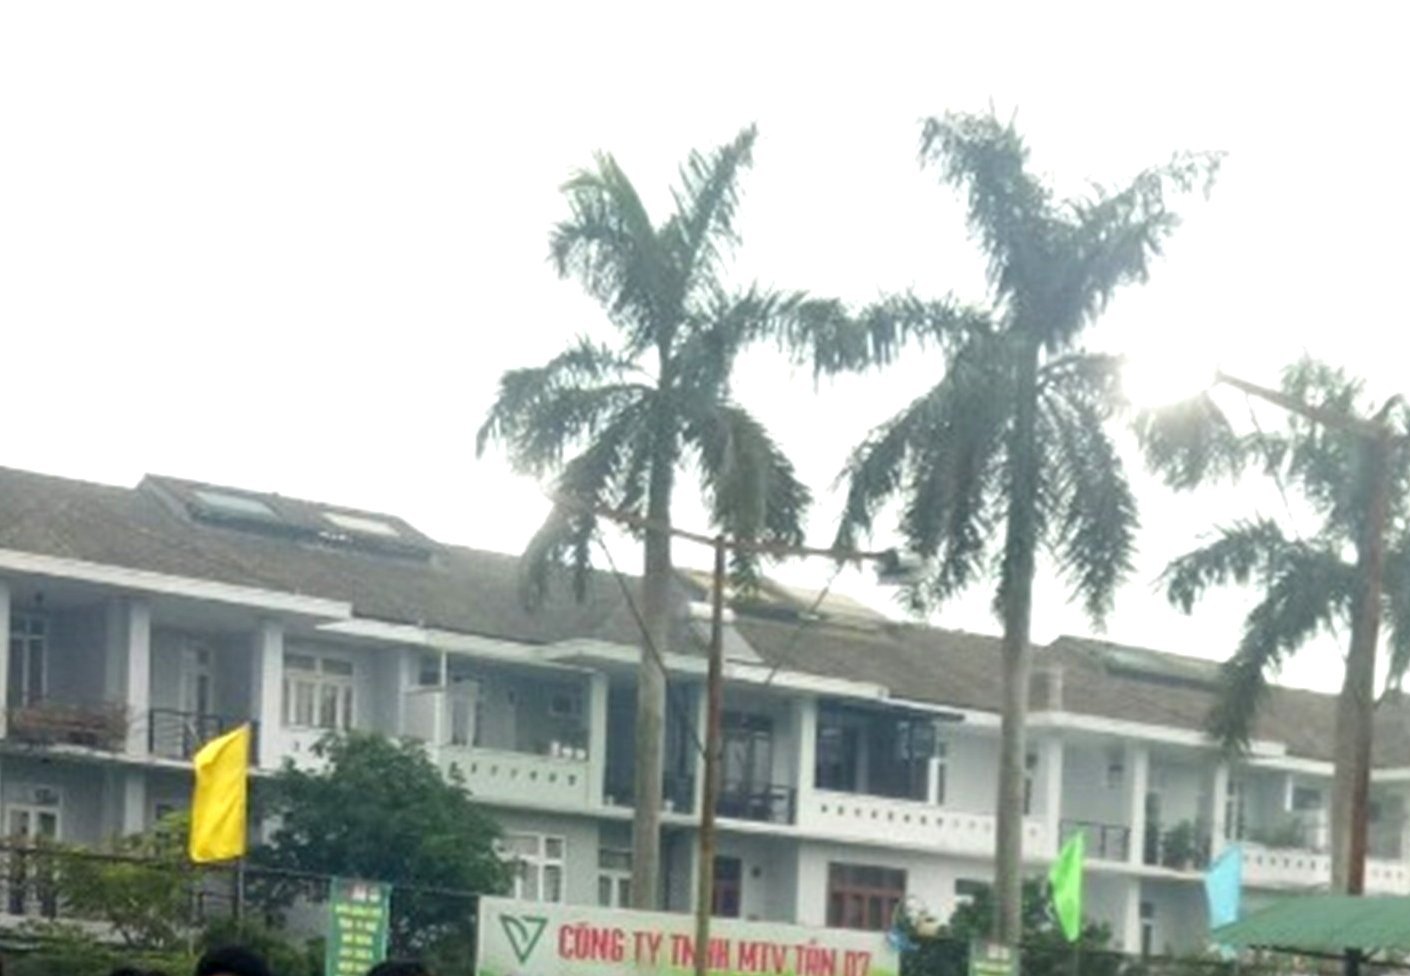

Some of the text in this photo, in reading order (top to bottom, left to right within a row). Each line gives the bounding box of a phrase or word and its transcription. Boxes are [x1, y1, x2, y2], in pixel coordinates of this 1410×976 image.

[558, 921, 625, 963] CÔNG
[633, 930, 661, 965] TY
[738, 940, 787, 975] MTV
